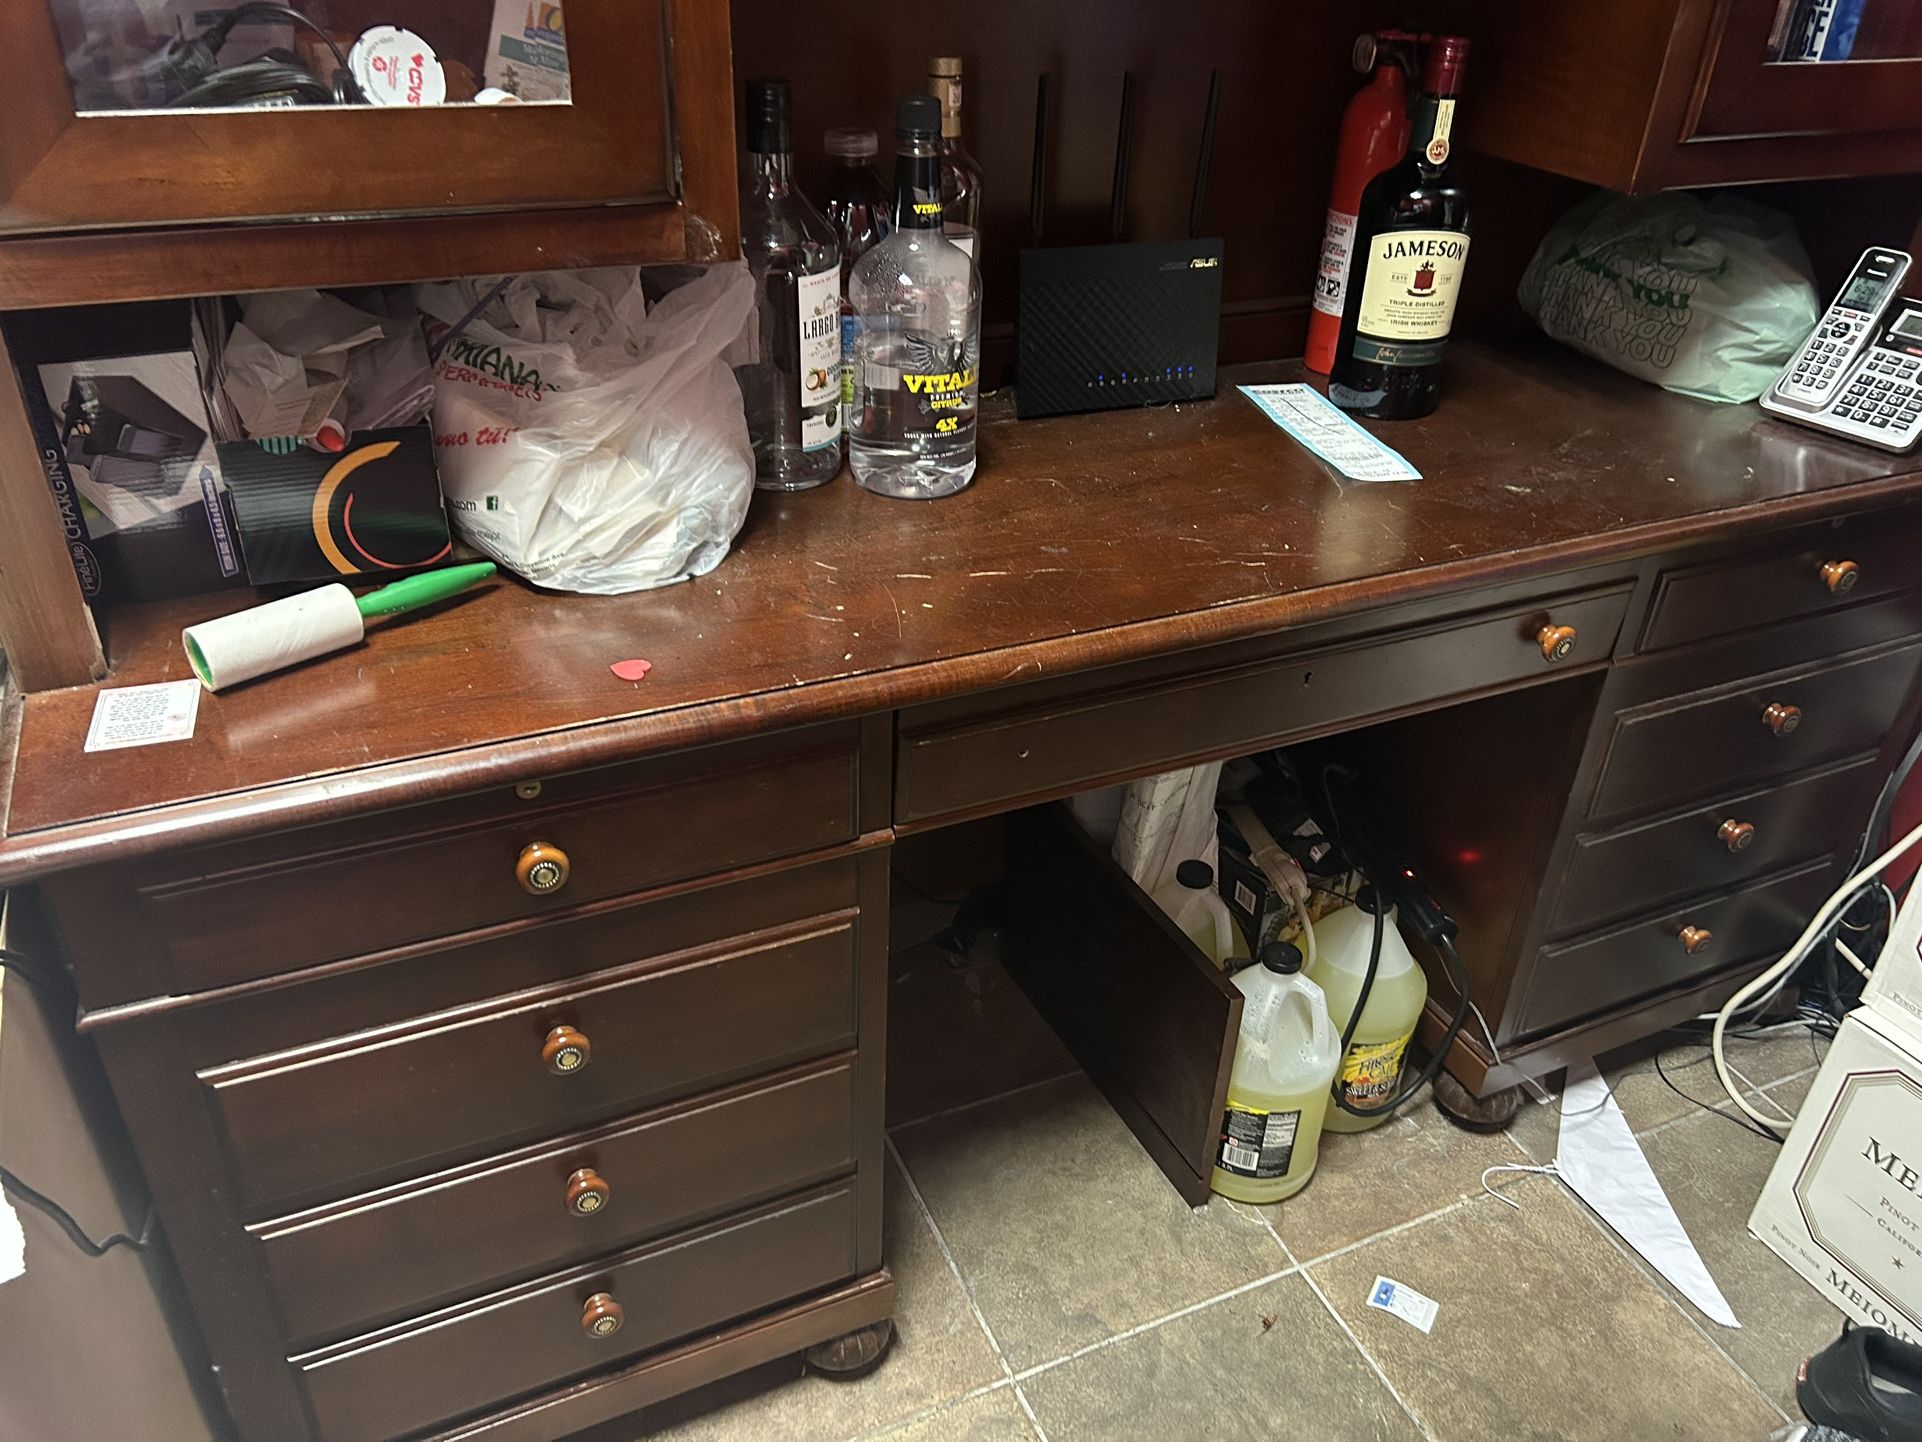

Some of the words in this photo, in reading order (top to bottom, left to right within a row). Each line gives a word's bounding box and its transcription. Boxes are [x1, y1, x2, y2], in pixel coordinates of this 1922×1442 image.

[407, 67, 424, 106] CVS
[1189, 257, 1218, 269] ASUS
[1383, 241, 1465, 261] JAMESON
[1389, 299, 1413, 307] TRIPLE
[1415, 300, 1446, 308] DISTILLED
[803, 313, 834, 340] LARGO
[935, 416, 959, 432] 4X
[46, 448, 82, 541] CHARGING
[1861, 1136, 1922, 1199] ME
[1879, 1196, 1919, 1232] PINOT
[1825, 1268, 1918, 1345] MEIOM
